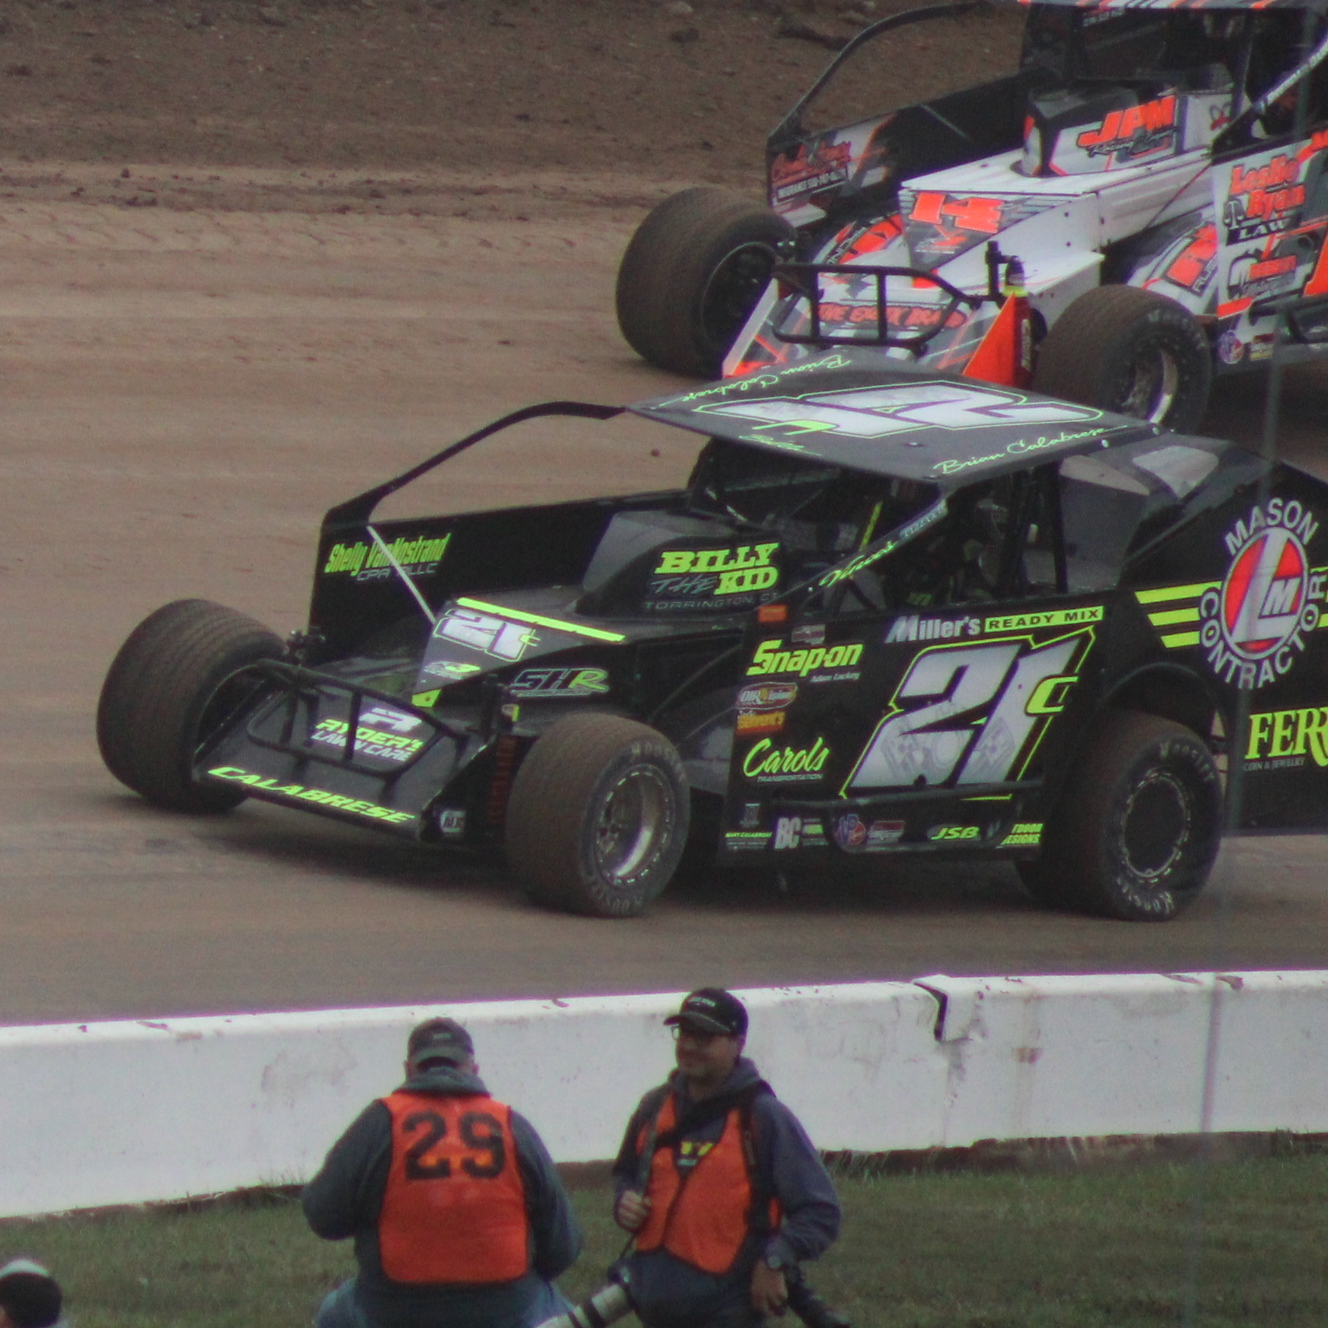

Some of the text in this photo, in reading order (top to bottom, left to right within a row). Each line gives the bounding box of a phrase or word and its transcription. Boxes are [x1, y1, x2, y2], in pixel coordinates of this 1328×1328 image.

[1077, 95, 1175, 147] JAM
[934, 451, 1004, 475] Brian
[1224, 497, 1320, 556] MASON
[654, 542, 779, 574] BILLY
[650, 567, 778, 595] THE KID
[884, 609, 1098, 643] Miller's READY MIX
[746, 639, 864, 677] Snap-on
[363, 741, 412, 762] CARE
[743, 737, 830, 777] Carols
[207, 767, 415, 823] CALABRESE
[931, 826, 979, 840] JSB
[402, 1110, 505, 1180] 29
